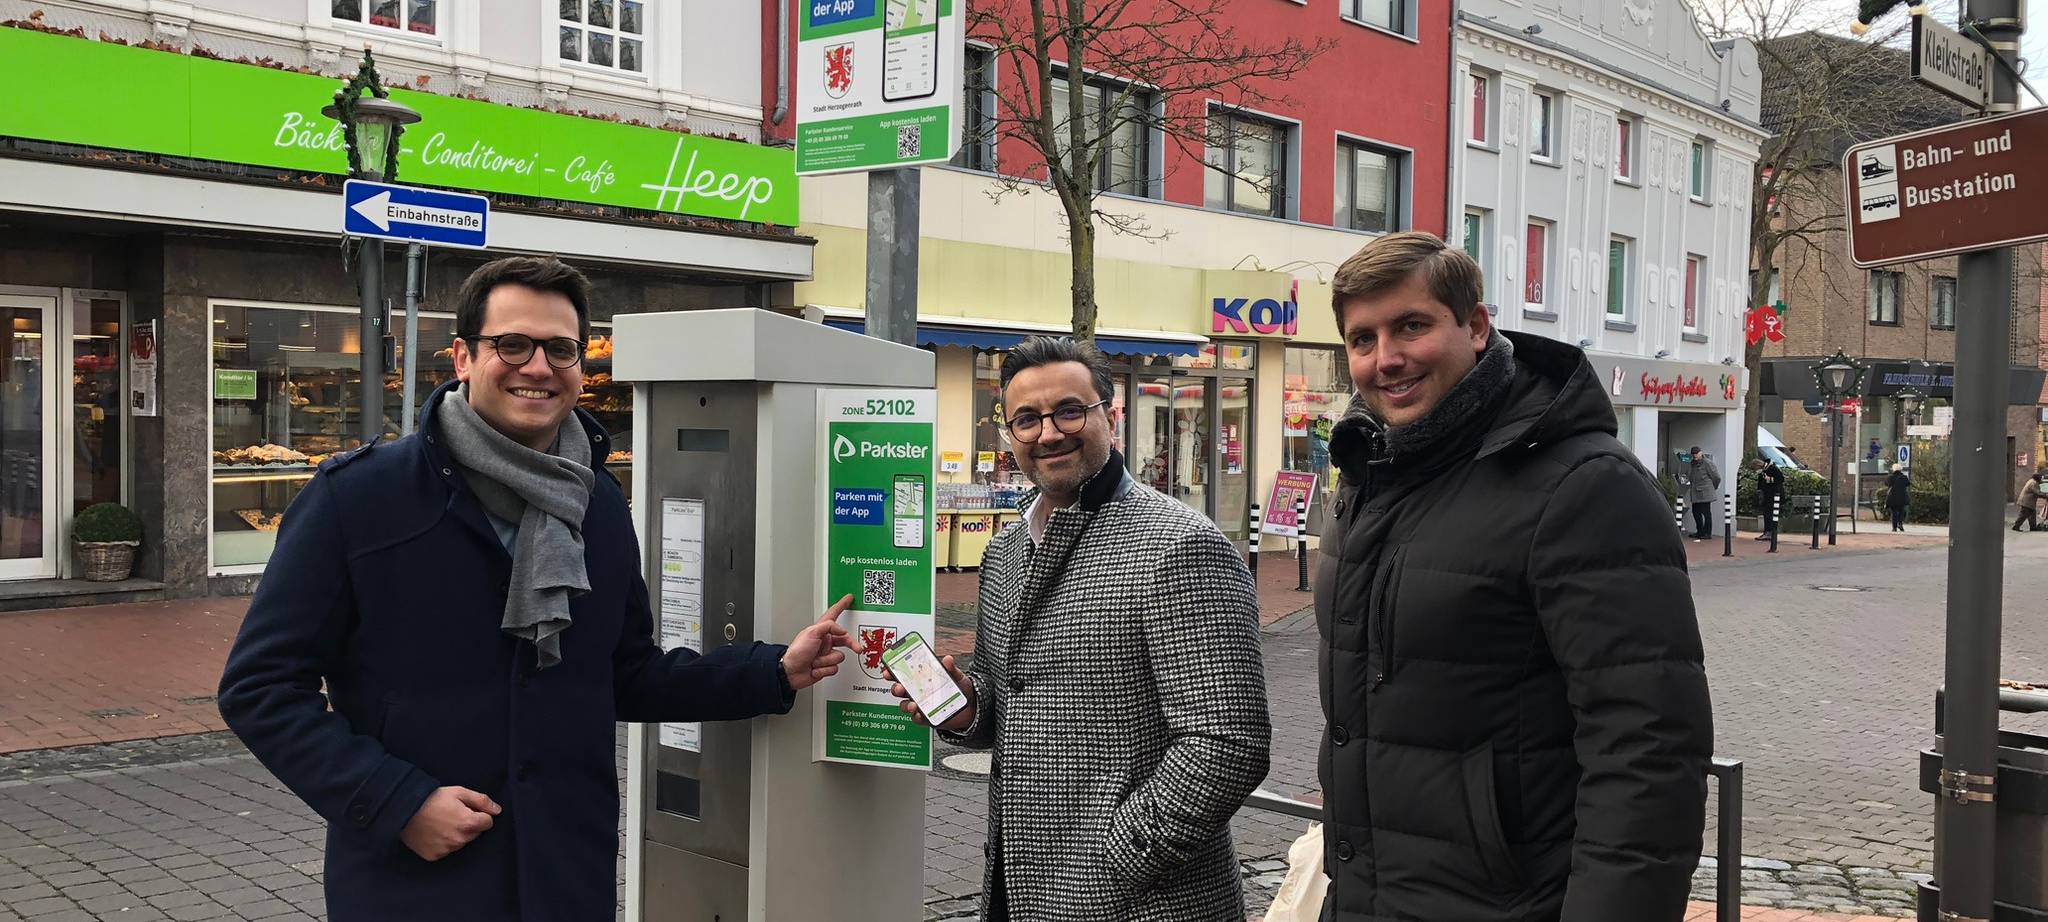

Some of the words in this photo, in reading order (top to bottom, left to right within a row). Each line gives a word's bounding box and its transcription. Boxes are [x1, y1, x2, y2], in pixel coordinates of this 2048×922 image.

[814, 3, 831, 17] der
[833, 0, 855, 15] App
[1925, 28, 1984, 90] Kleikstraße
[813, 104, 827, 113] Stadt
[827, 100, 863, 112] Herzogenrath
[880, 120, 891, 129] App
[892, 117, 919, 127] kostenlos
[920, 115, 937, 123] laden
[274, 111, 352, 152] Bäck
[422, 132, 539, 175] Conditorei
[564, 155, 616, 194] Café
[1902, 144, 1964, 170] Bahn-
[1973, 129, 2012, 156] und
[640, 136, 774, 220] Heep
[1905, 171, 2016, 208] Busstation
[387, 206, 479, 228] Einbahnstraße
[1528, 281, 1541, 302] 16
[373, 317, 380, 326] 17
[842, 407, 865, 415] ZONE
[866, 399, 915, 416] 52102
[860, 441, 929, 458] Parkster
[1278, 479, 1312, 489] WERBUNG
[835, 491, 866, 502] Parken
[867, 492, 884, 502] mit
[834, 506, 849, 516] der
[851, 507, 870, 518] App
[961, 519, 989, 533] KODI
[840, 555, 856, 565] App
[857, 556, 895, 566] kostenlos
[896, 558, 918, 567] laden
[868, 686, 891, 694] Herzoge
[842, 710, 867, 718] Parkster
